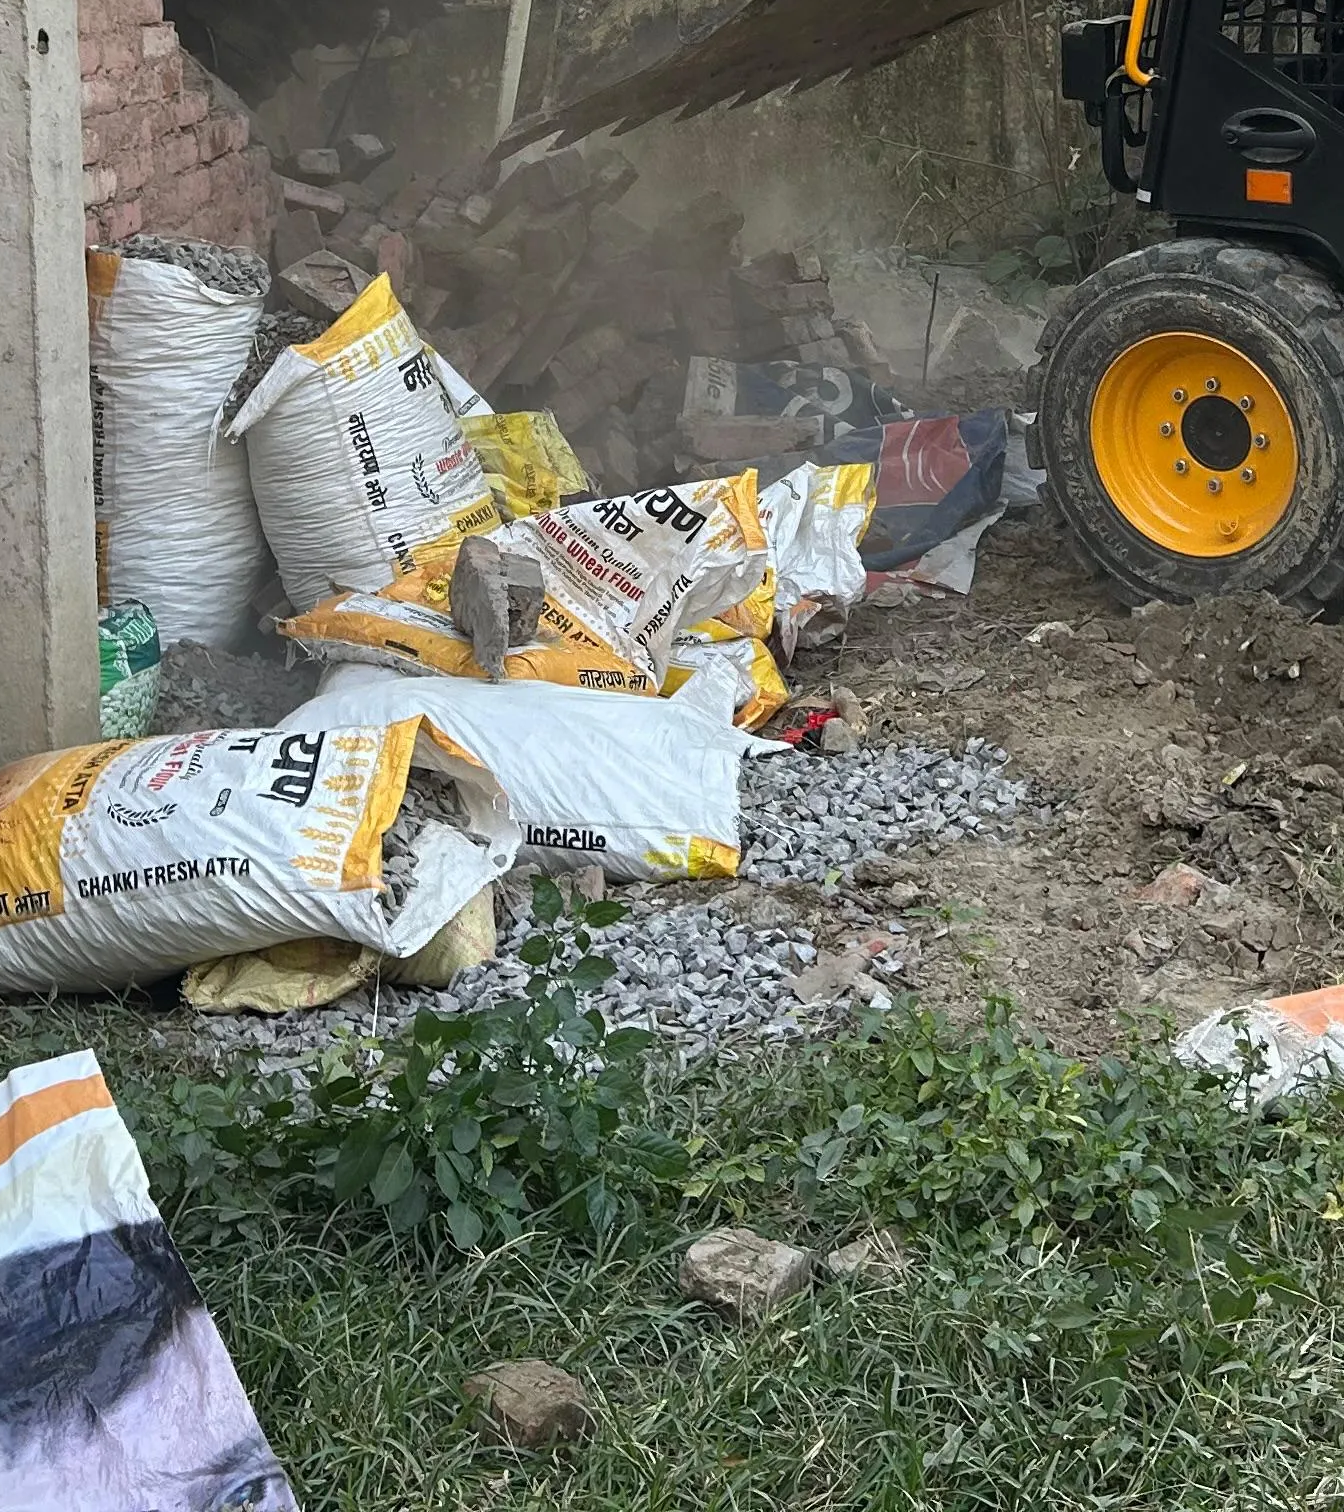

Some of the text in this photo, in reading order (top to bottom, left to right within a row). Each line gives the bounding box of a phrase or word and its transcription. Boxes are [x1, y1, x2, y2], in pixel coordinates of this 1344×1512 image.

[92, 400, 105, 448] FRESH
[456, 504, 493, 534] CHAKKI
[592, 498, 645, 542] भोग
[536, 512, 646, 602] hole Wheat Flour
[601, 547, 643, 580] Quality
[576, 668, 626, 690] नारायण
[62, 772, 93, 811] ATTA
[525, 824, 607, 853] नारायण
[77, 856, 251, 899] CHAKKI FRESH ATTA
